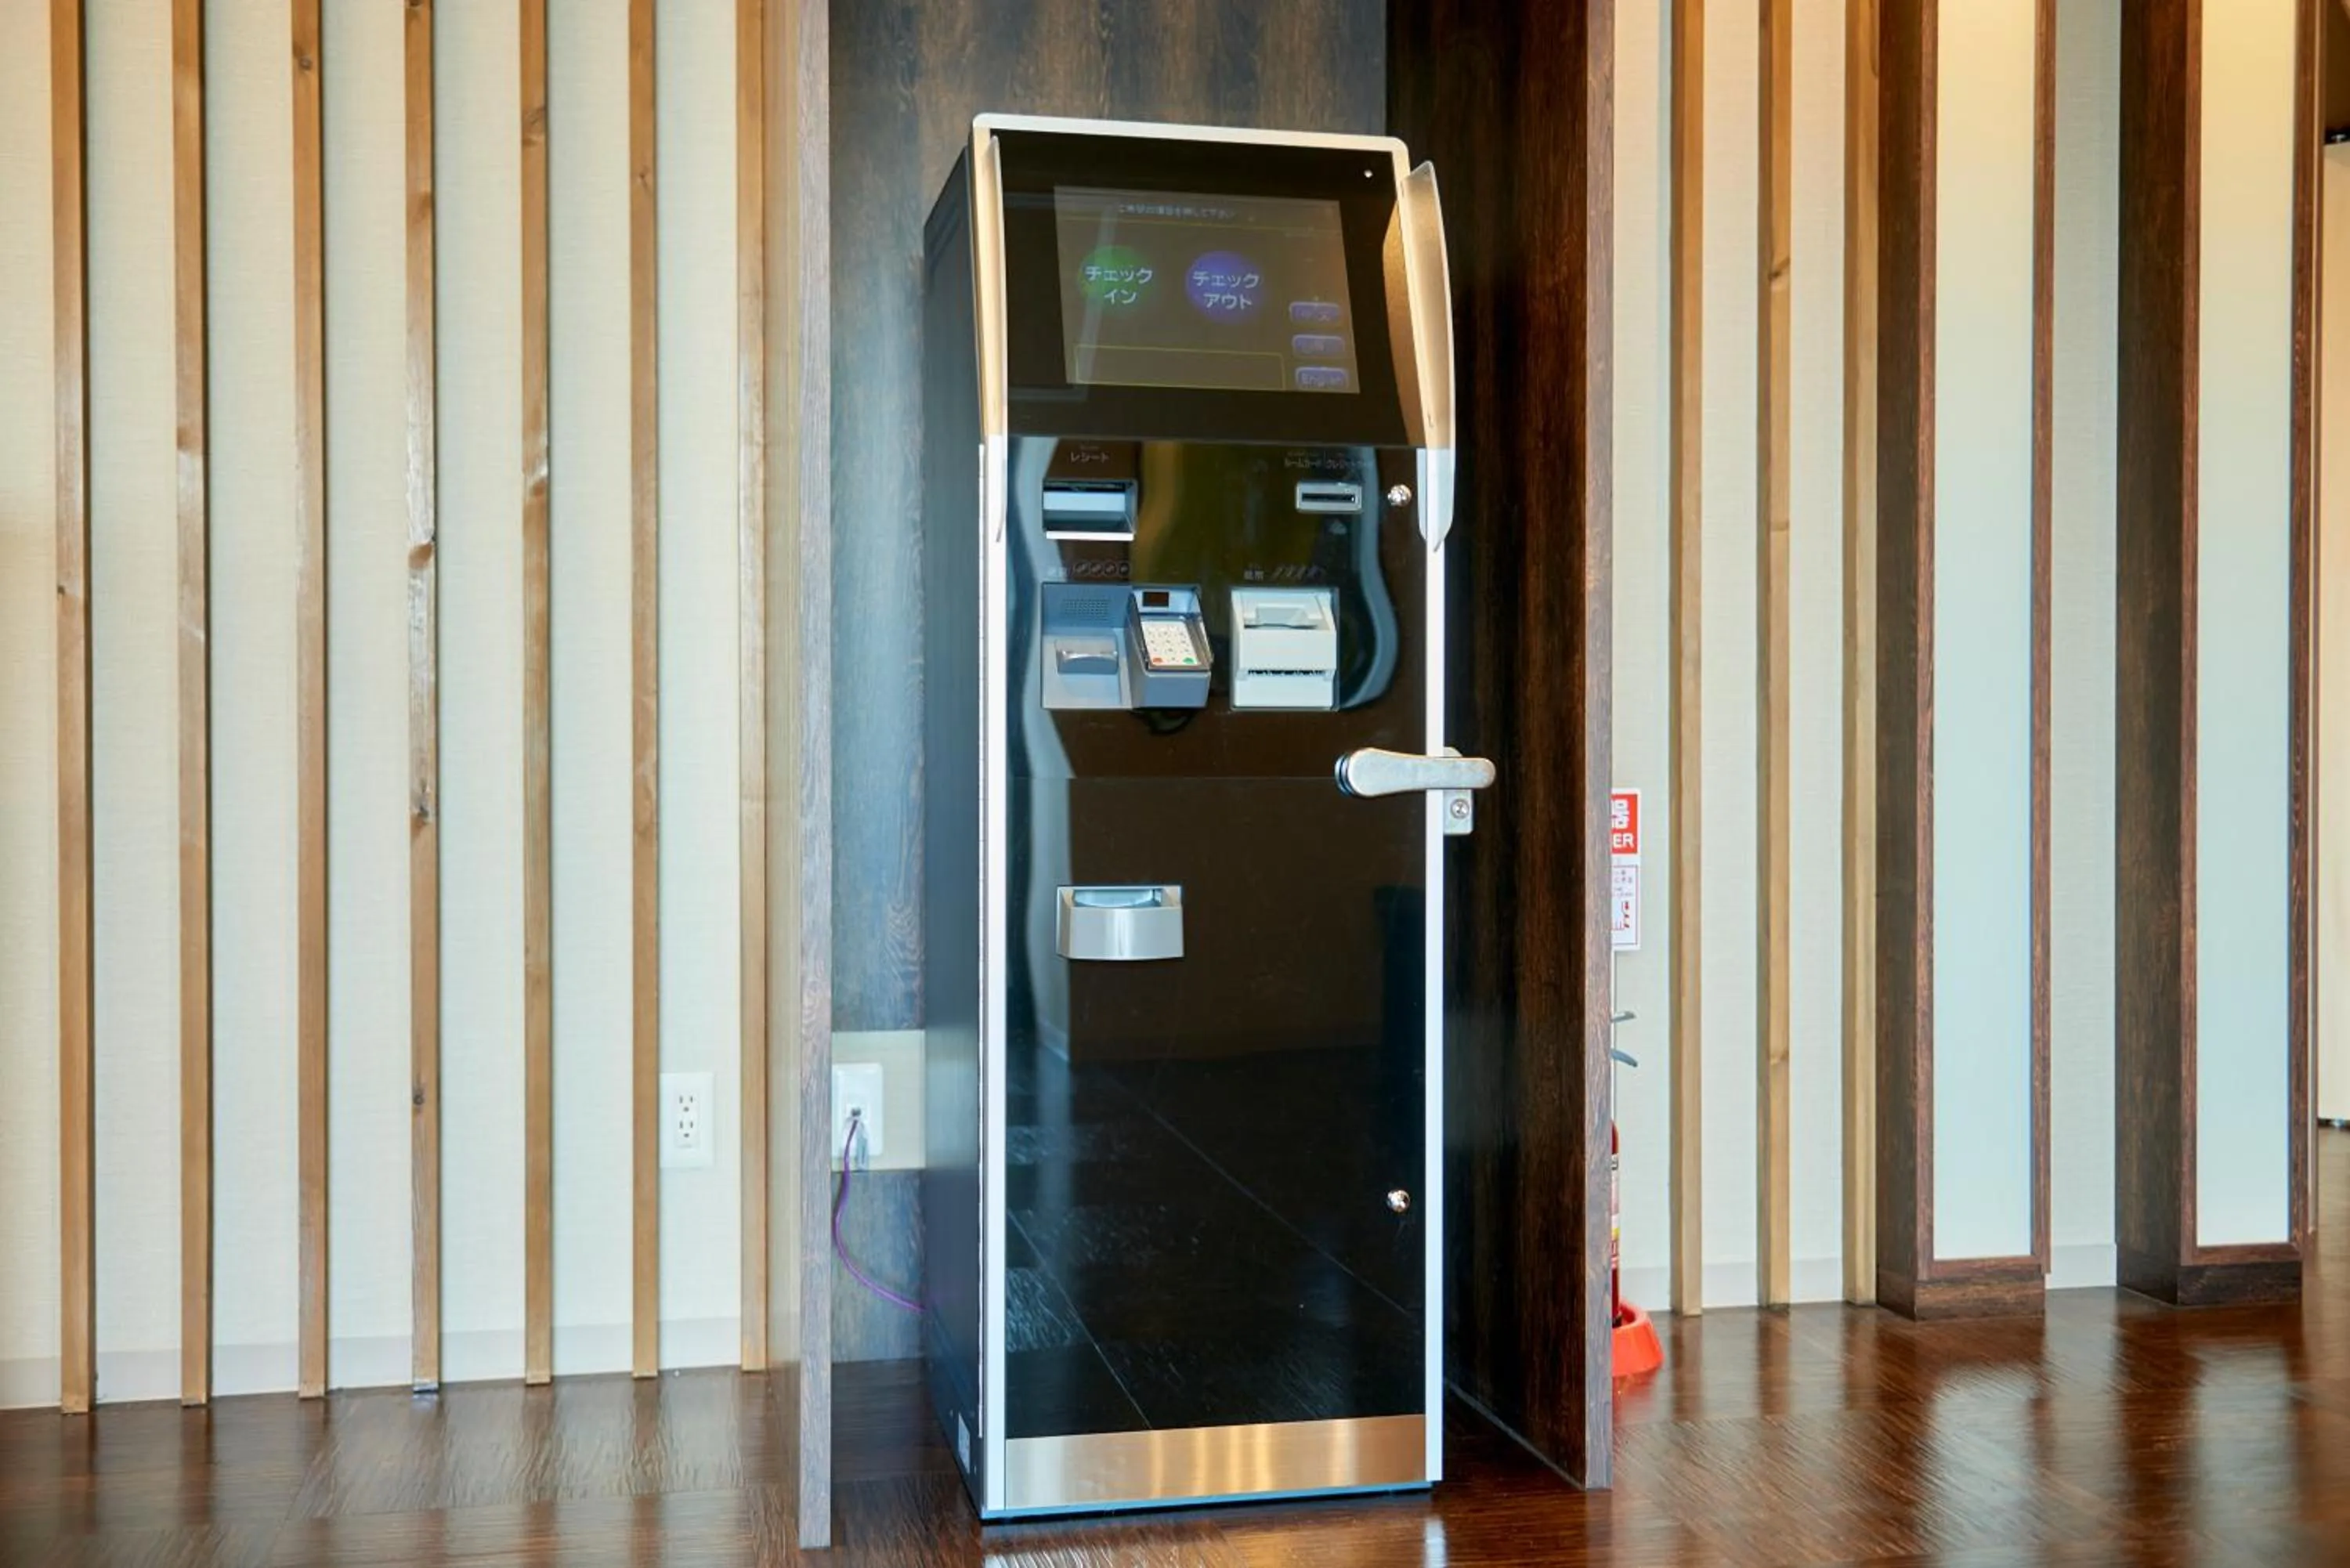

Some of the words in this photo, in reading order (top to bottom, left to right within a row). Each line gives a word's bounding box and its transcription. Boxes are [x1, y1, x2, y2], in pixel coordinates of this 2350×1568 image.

[1084, 266, 1153, 284] チェック
[1192, 271, 1260, 289] チェック
[1104, 289, 1137, 305] イン
[1204, 293, 1253, 309] アウト
